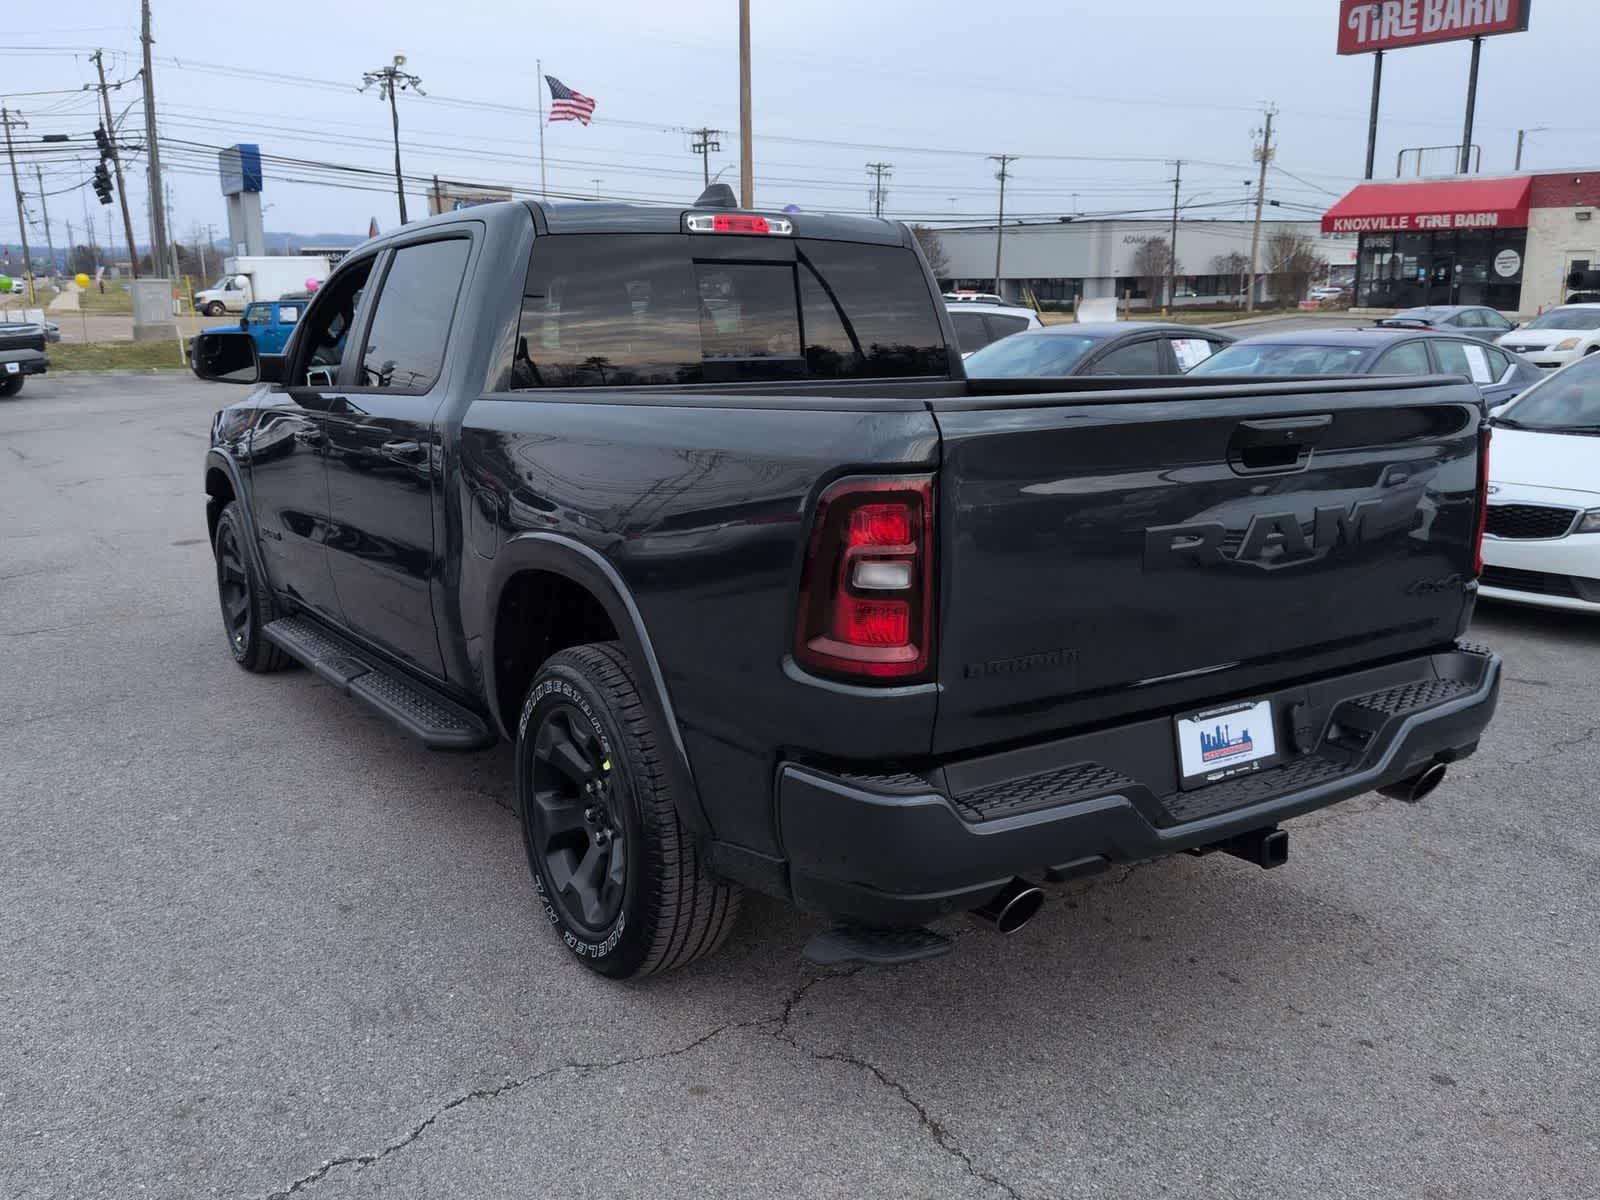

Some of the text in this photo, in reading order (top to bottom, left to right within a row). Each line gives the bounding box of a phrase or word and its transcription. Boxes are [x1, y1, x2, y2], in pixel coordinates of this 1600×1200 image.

[1422, 0, 1508, 33] BARN
[1334, 216, 1408, 231] KNOXVILLE
[1455, 213, 1498, 227] BARN
[1144, 498, 1384, 574] RAM
[518, 679, 613, 753] BRIDGESTONE
[563, 911, 626, 958] DUELER
